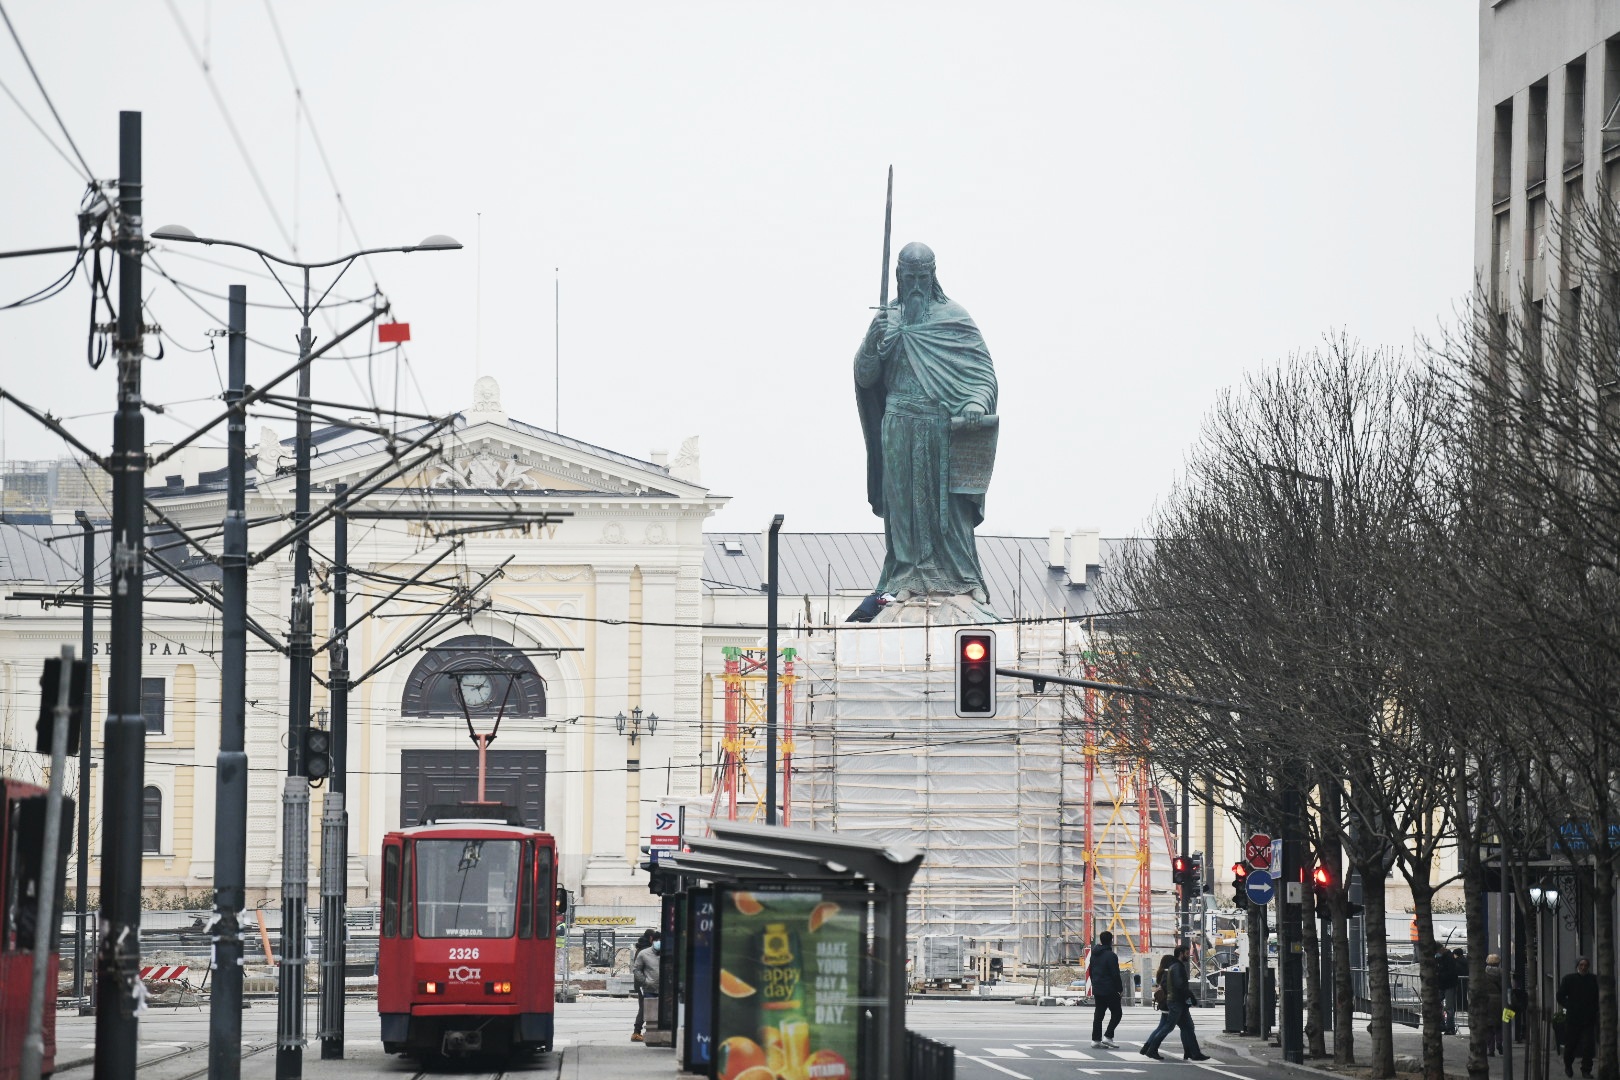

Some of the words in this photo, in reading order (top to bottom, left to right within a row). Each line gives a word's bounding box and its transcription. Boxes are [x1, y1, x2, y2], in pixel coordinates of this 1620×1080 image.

[1249, 845, 1271, 858] STOP
[449, 947, 480, 960] 2326
[815, 942, 848, 957] MAKE
[816, 959, 848, 974] YOUR
[815, 976, 837, 990] DAY
[840, 976, 848, 990] A
[763, 982, 795, 1001] day
[814, 1006, 848, 1024] DAY.
